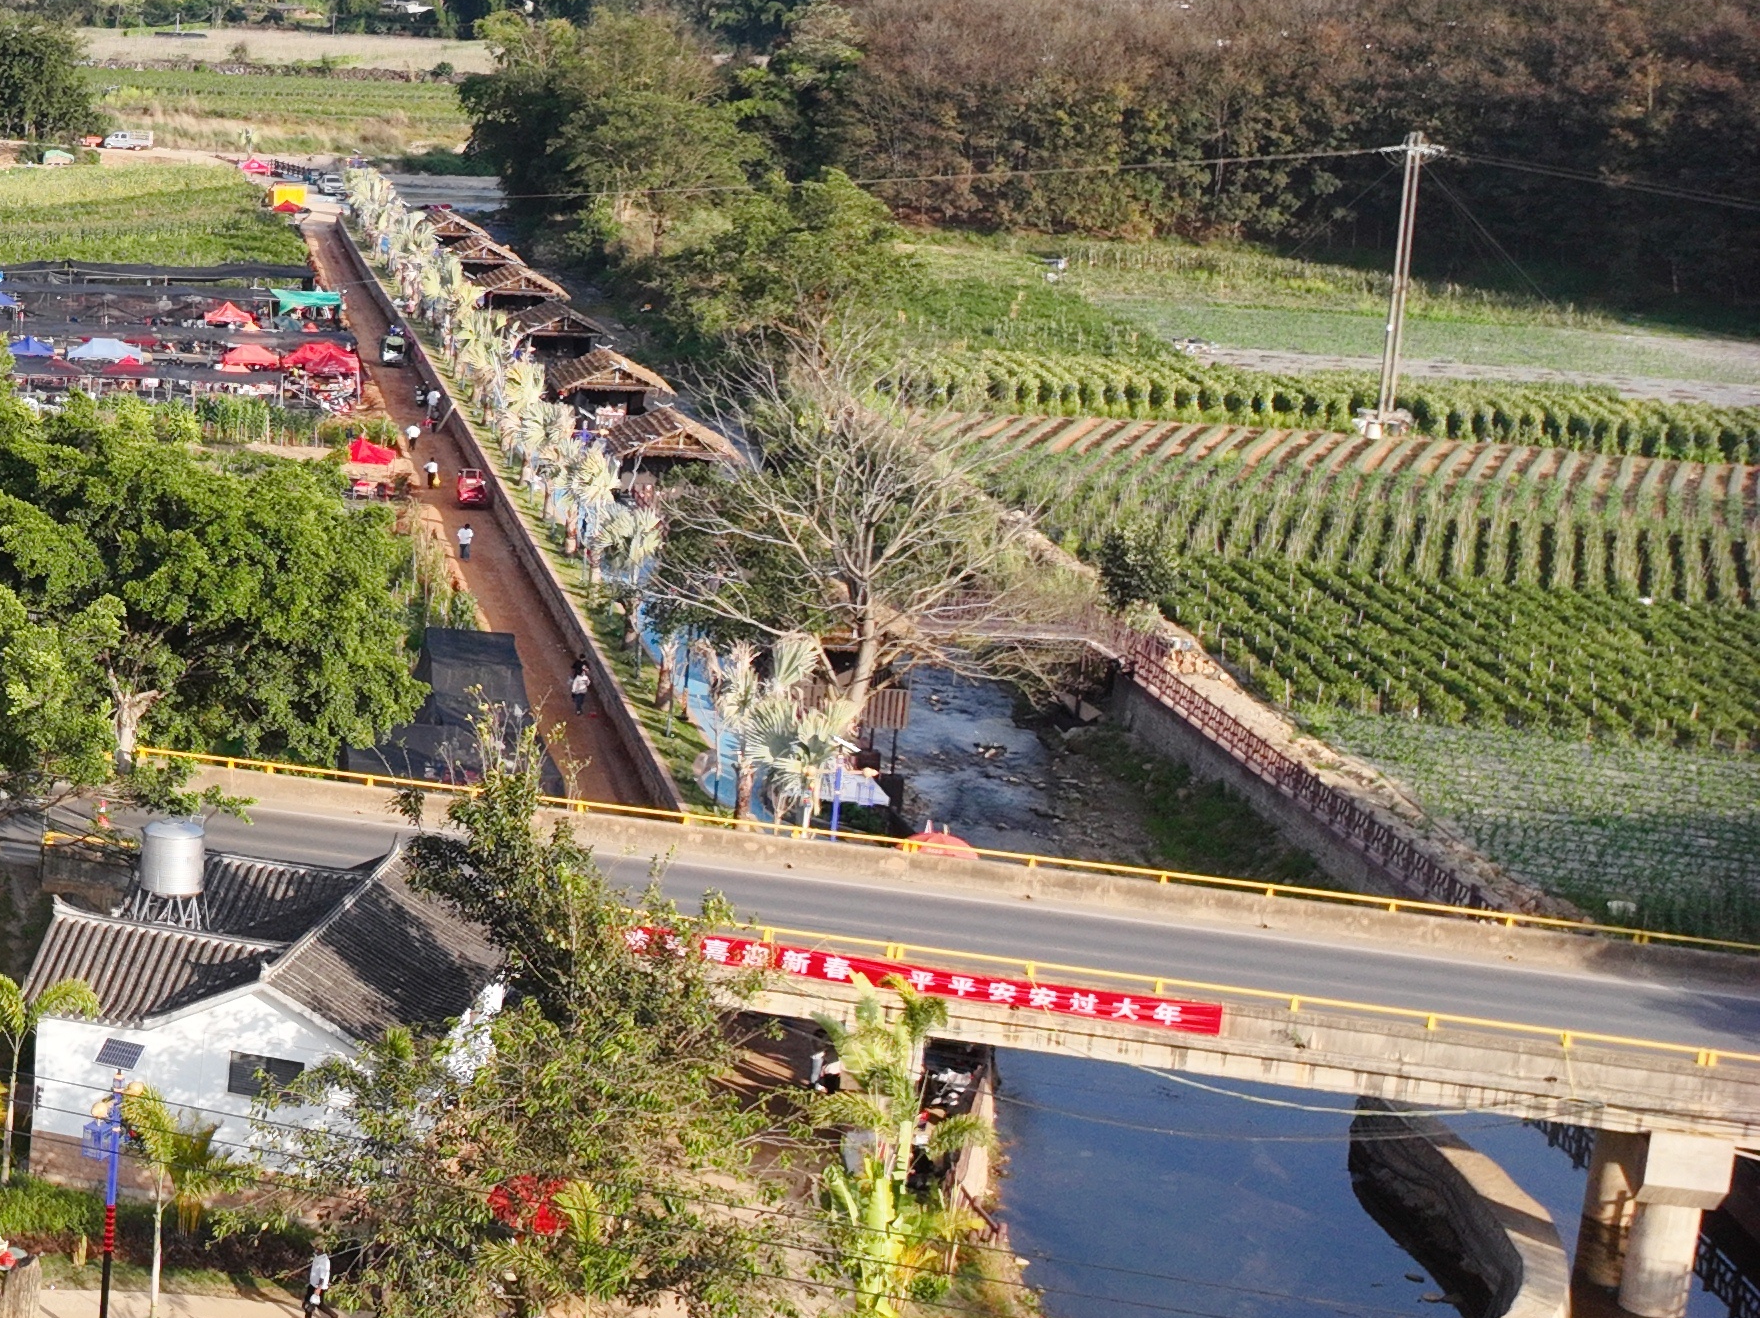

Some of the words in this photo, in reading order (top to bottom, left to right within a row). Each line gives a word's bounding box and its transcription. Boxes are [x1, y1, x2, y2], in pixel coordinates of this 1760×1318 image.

[908, 970, 1182, 1026] 平平安安过大年
